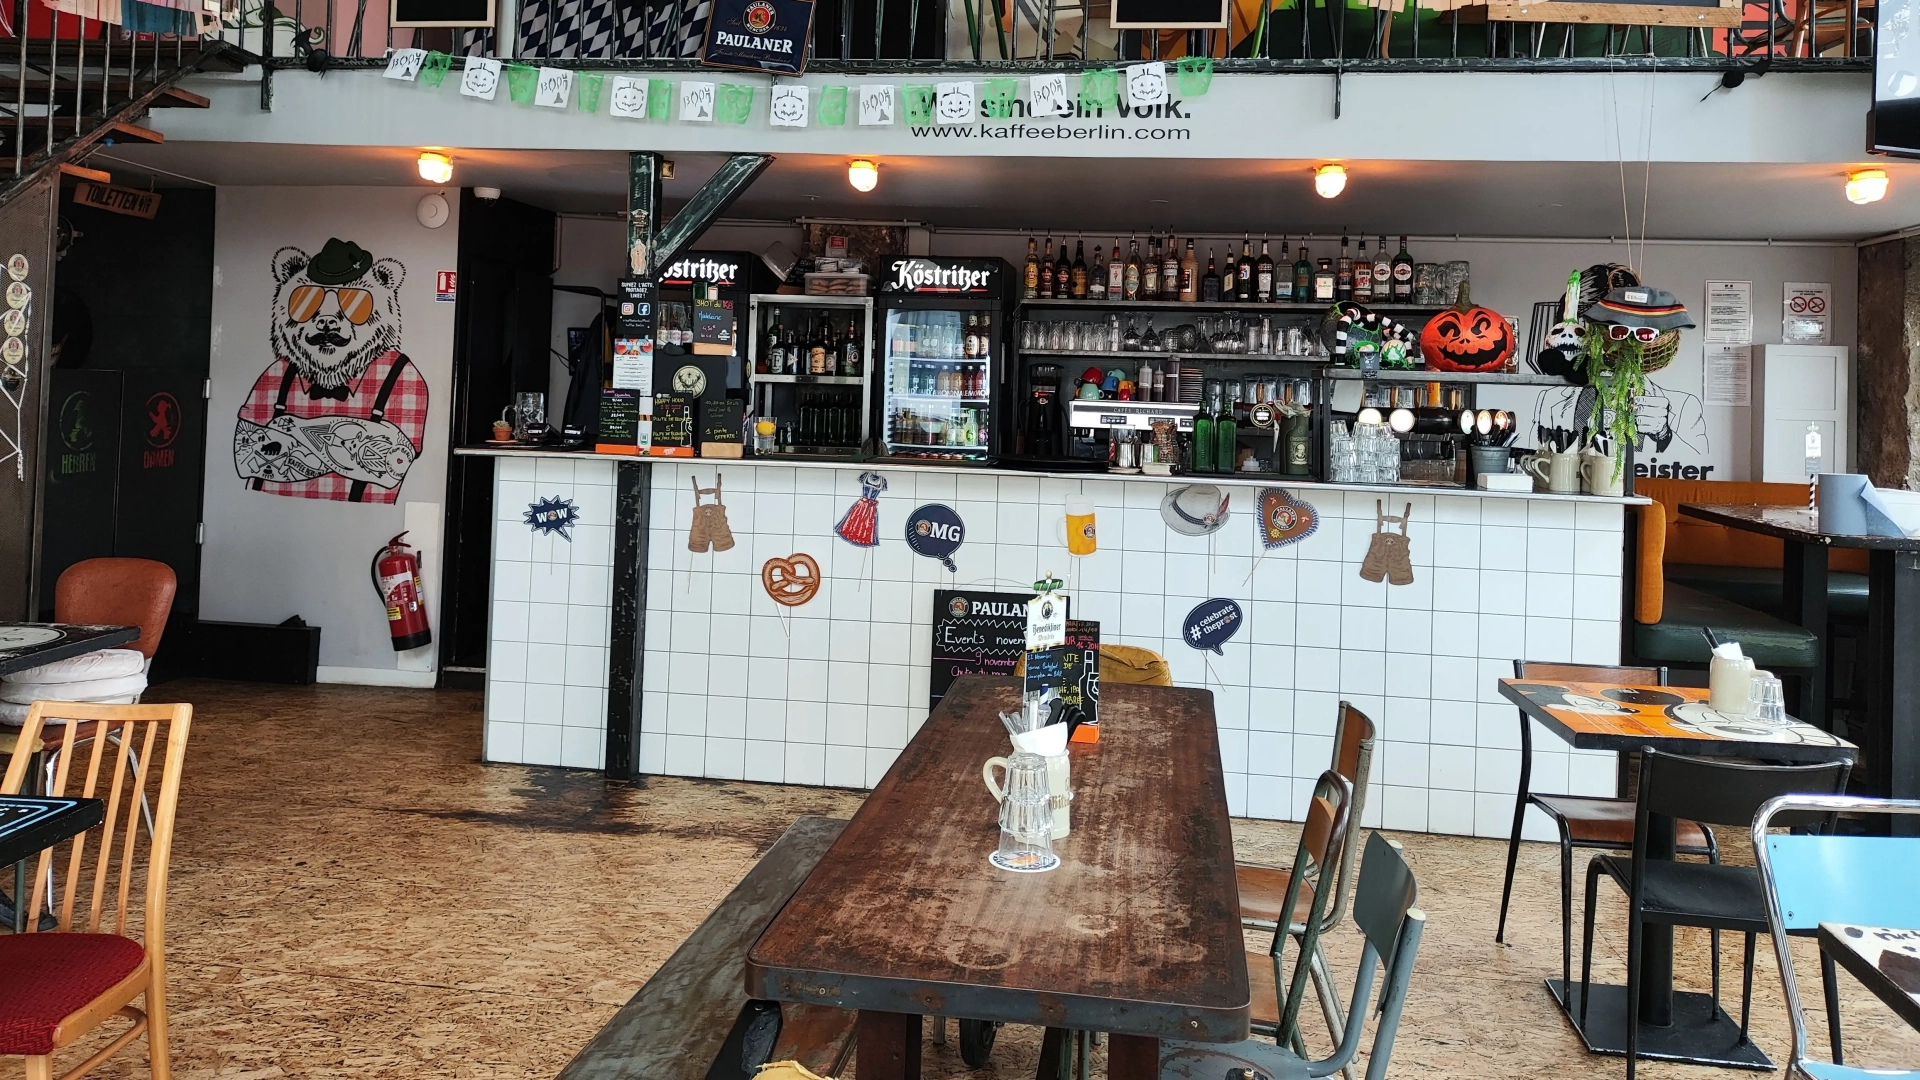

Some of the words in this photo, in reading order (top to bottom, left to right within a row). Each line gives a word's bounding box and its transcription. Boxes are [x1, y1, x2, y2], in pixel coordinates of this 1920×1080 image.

[715, 31, 793, 54] PAULANER
[911, 124, 1191, 140] www.kaffeeberlin.com
[85, 184, 139, 212] TOILETTEN
[61, 452, 96, 475] HERREN
[143, 449, 175, 469] DAMEN
[944, 626, 985, 645] Events
[975, 651, 982, 666] 9
